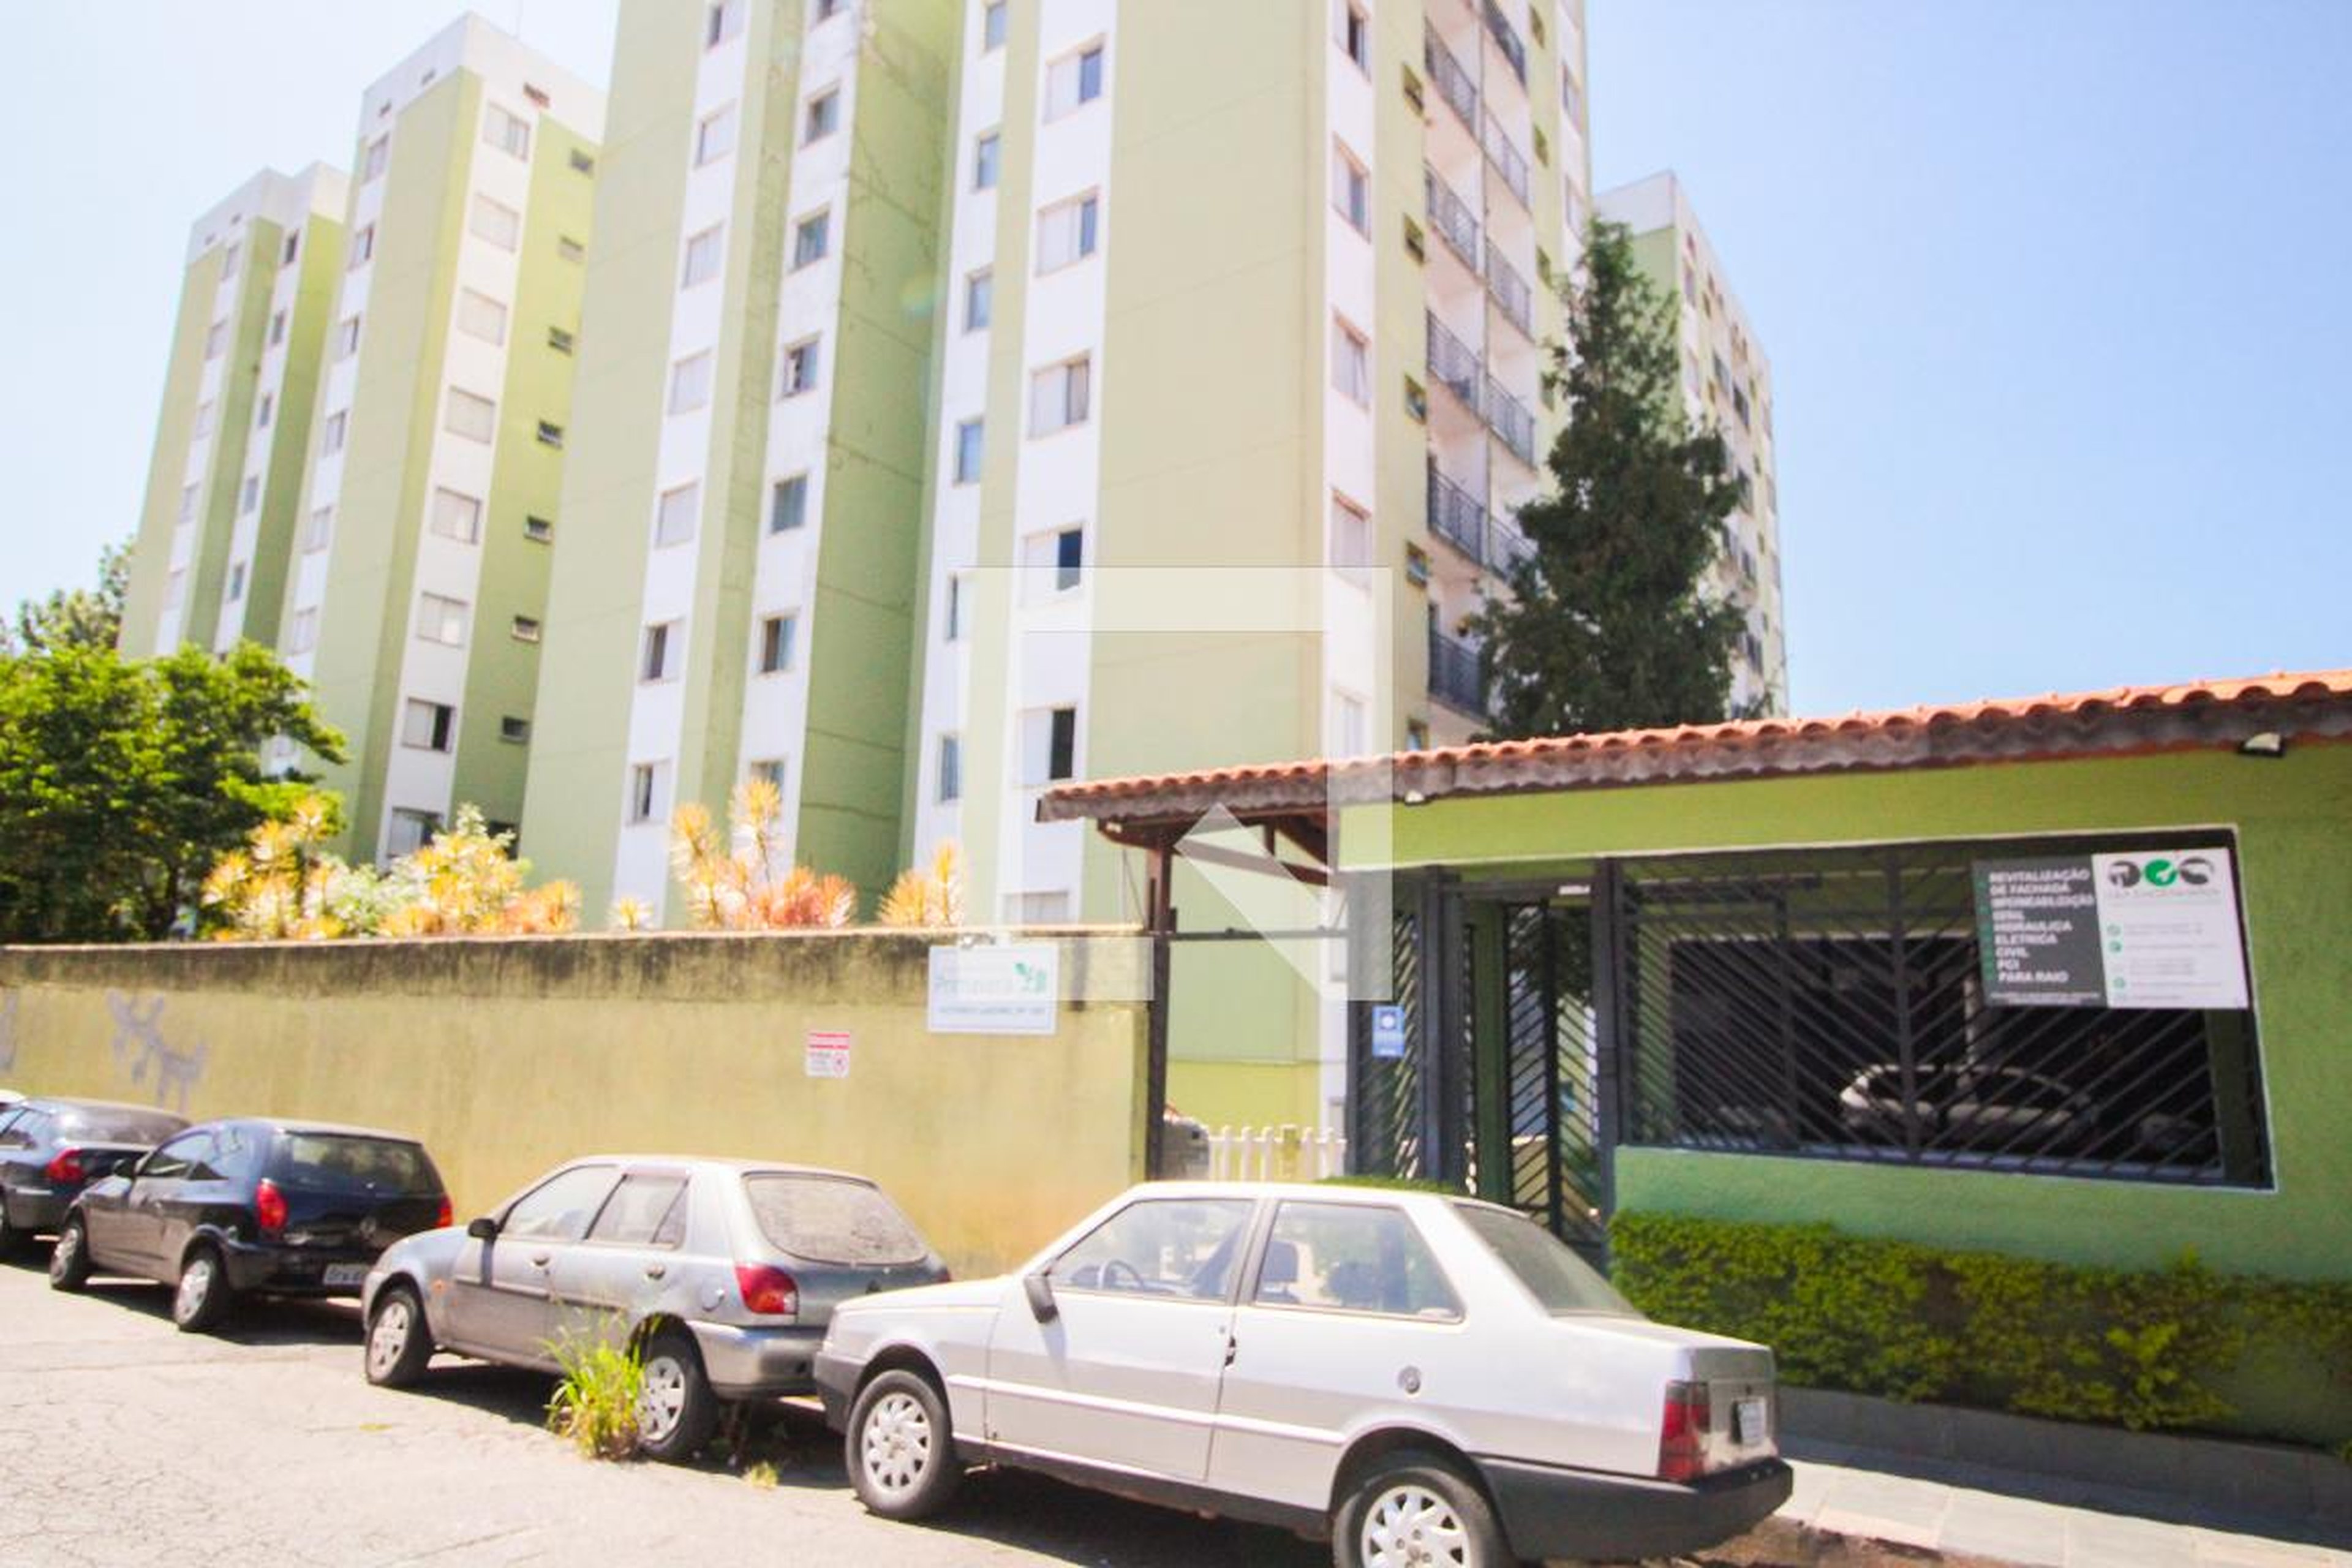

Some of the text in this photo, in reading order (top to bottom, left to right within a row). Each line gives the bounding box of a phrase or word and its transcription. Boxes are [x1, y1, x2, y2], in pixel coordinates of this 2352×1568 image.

[1989, 867, 2090, 883] REVITALIZAÇÃO
[1991, 882, 2071, 896] DE FACHADA
[1996, 947, 2030, 958] CIVIL
[2035, 970, 2070, 983] RAIO
